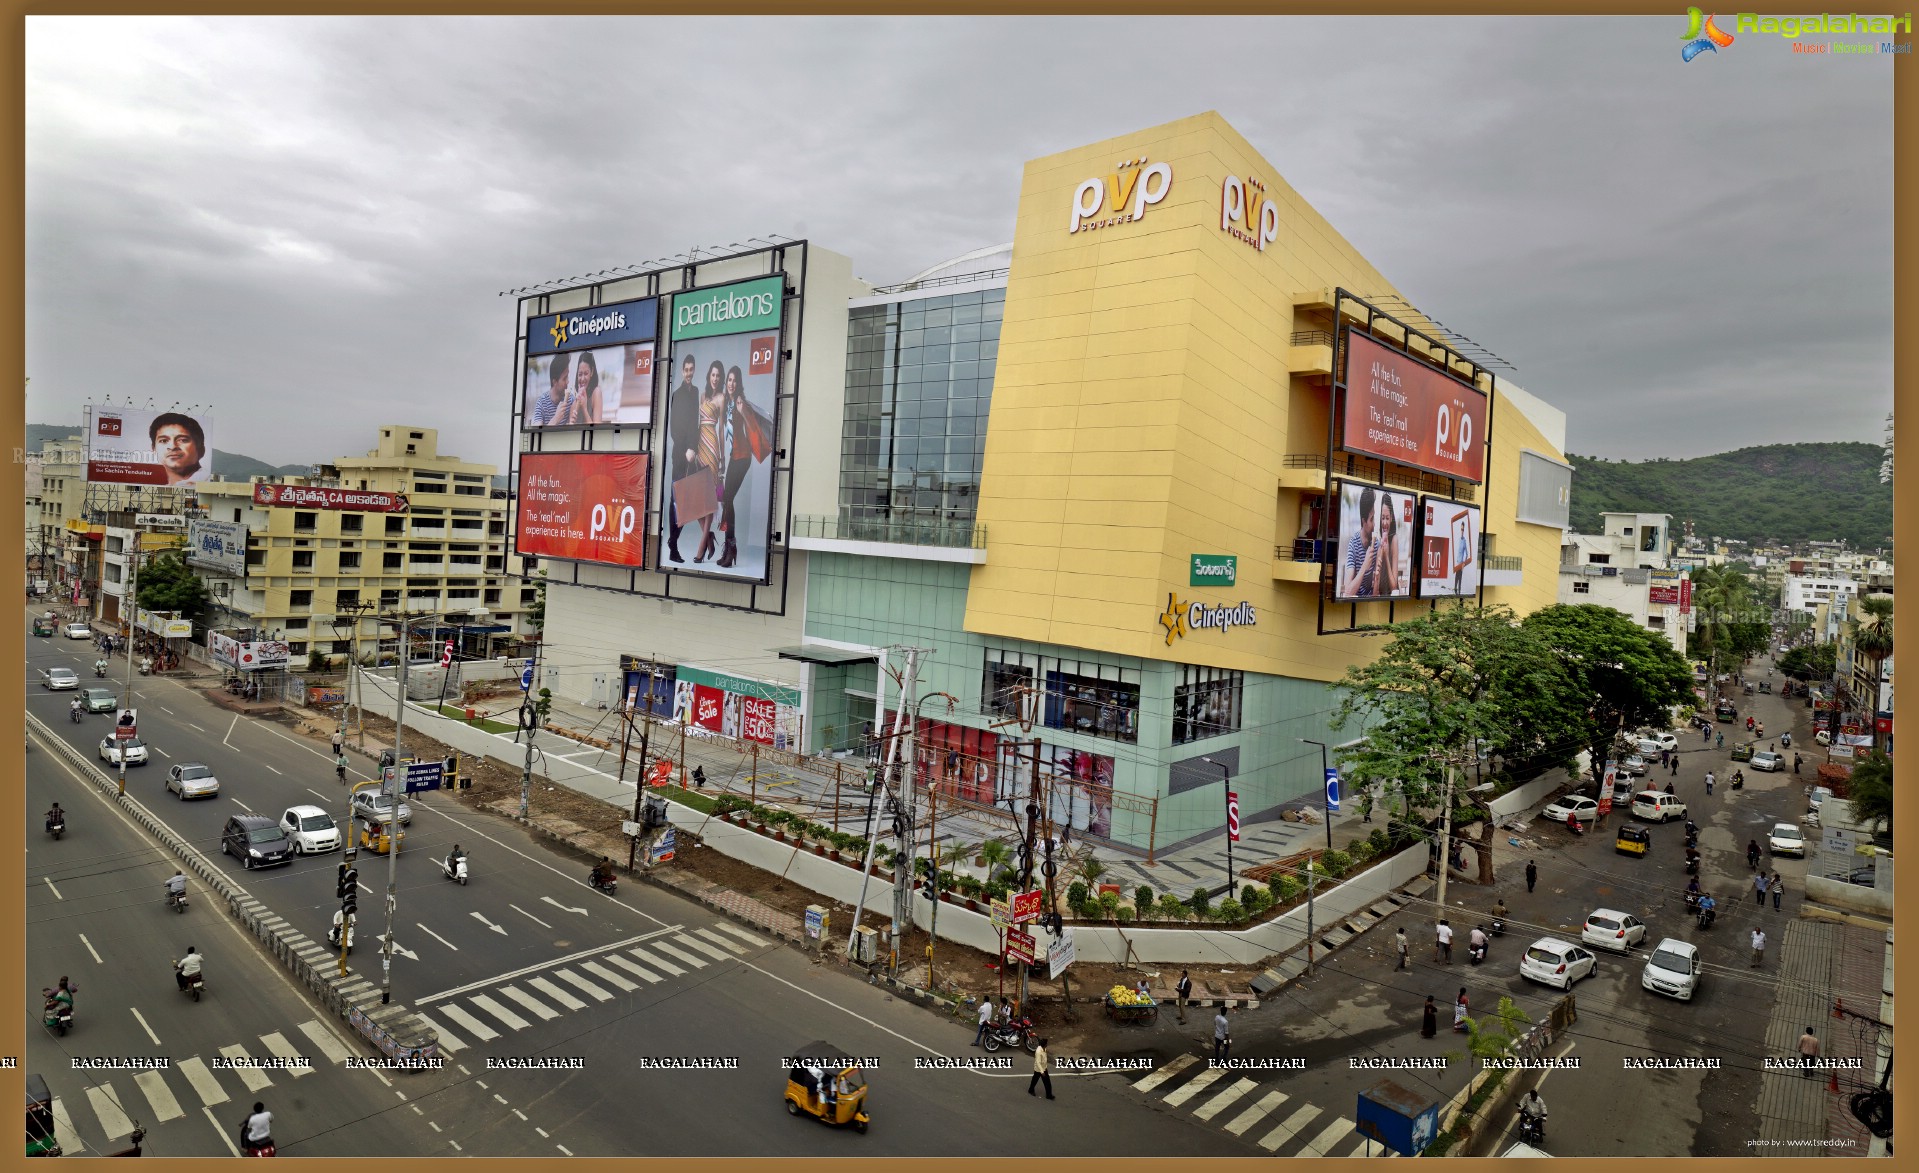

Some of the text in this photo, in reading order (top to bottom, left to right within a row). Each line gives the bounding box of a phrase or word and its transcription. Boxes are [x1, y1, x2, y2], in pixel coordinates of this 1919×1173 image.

[1082, 214, 1133, 231] SQUARE
[678, 291, 773, 332] pantaloons
[569, 311, 625, 336] Cinépolis
[1371, 361, 1379, 377] All
[1381, 365, 1390, 382] the
[1371, 379, 1379, 395] All
[1381, 383, 1389, 399] the
[1370, 405, 1380, 424] The
[1396, 415, 1408, 432] mall
[1369, 428, 1399, 444] experience
[528, 475, 562, 488] All the fun.
[330, 493, 343, 503] CA
[527, 489, 571, 504] All the magic.
[527, 509, 537, 521] The
[555, 512, 570, 524] mall
[526, 525, 586, 540] experience is here.
[1428, 540, 1441, 569] fun
[1189, 601, 1256, 633] Cinépolis
[715, 676, 756, 694] pantaloons
[698, 704, 718, 721] Sale
[745, 700, 774, 719] SALE
